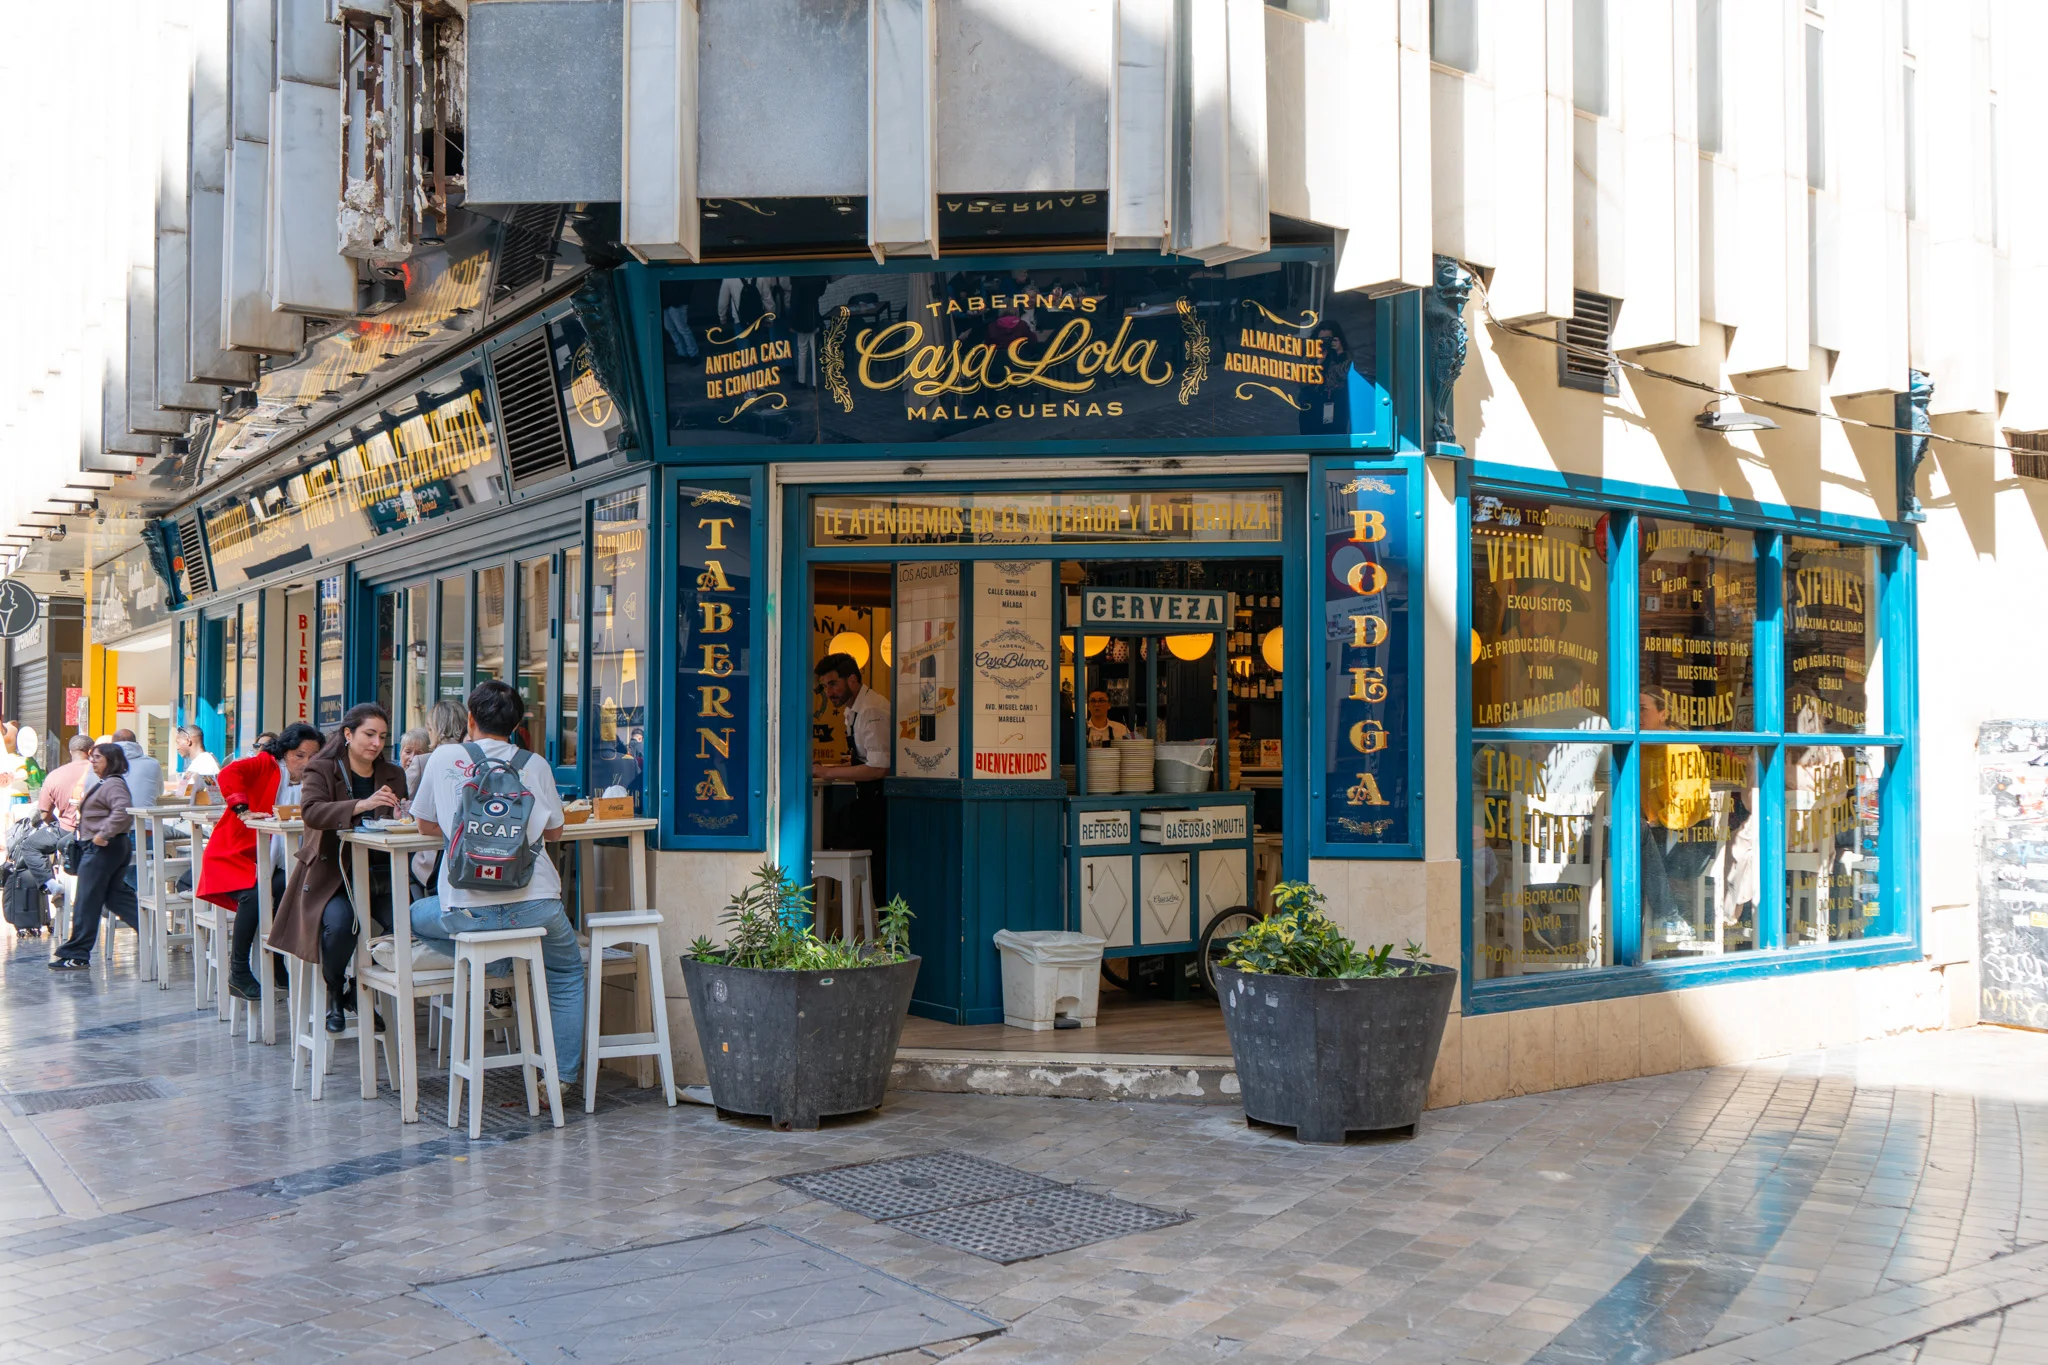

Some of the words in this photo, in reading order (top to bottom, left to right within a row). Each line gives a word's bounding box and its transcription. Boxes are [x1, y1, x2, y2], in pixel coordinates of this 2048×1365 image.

[926, 293, 1097, 317] TABERNAS
[1240, 328, 1302, 357] ALMACÉN
[1306, 339, 1324, 359] DE
[705, 347, 759, 375] ANTIGUA
[760, 340, 792, 362] CASA
[856, 321, 1009, 397] Casa
[1007, 316, 1174, 394] Lola
[1224, 352, 1324, 385] AGUARDIENTES
[707, 381, 723, 399] DE
[725, 366, 781, 397] COMIDAS
[907, 400, 1123, 421] MALAGUEÑAS
[393, 389, 491, 488] GENEROSOS
[824, 509, 844, 535] LE
[849, 507, 964, 535] ATENDEMOS
[971, 507, 994, 534] EN
[1002, 506, 1026, 533] EL
[1029, 505, 1120, 532] INTERIOR
[1130, 504, 1140, 530] Y
[1150, 504, 1173, 531] EN
[1179, 503, 1271, 531] TERRAZA
[1479, 502, 1521, 521] RECETA
[1526, 509, 1596, 530] TRADICIONAL
[598, 529, 642, 559] BARBADILLO
[1646, 528, 1721, 552] ALIMENTACIÓN
[900, 569, 913, 583] LOS
[915, 562, 959, 580] AGUILARES
[1487, 534, 1591, 592] VERMUTS
[1652, 568, 1662, 583] LO
[1662, 576, 1688, 594] MEJOR
[1707, 573, 1716, 589] LO
[988, 588, 1004, 596] CALLE
[1005, 588, 1029, 597] GRANADA
[1692, 590, 1703, 603] DE
[1716, 581, 1741, 599] MEJOR
[1796, 566, 1863, 614] SIFONES
[1002, 600, 1023, 609] MÁLAGA
[1092, 595, 1219, 621] CERVEZA
[1507, 594, 1572, 613] EXQUISITOS
[1796, 615, 1828, 631] MÁXIMA
[1830, 619, 1864, 634] CALIDAD
[1481, 645, 1493, 661] DE
[1496, 636, 1555, 657] PRODUCCIÓN
[1558, 640, 1598, 666] FAMILIAR
[1644, 636, 1684, 653] ABRIMOS
[1685, 639, 1711, 655] TODOS
[1713, 640, 1728, 656] LOS
[1730, 638, 1749, 657] DÍAS
[695, 517, 736, 801] TABERNA
[975, 651, 1006, 670] Casa
[1003, 652, 1049, 670] Blanca
[1347, 510, 1390, 806] BODEGA
[1793, 656, 1808, 672] CON
[1809, 654, 1831, 668] AGUAS
[1528, 665, 1534, 679] Y
[1536, 665, 1554, 680] UNA
[1678, 664, 1718, 681] NUESTRAS
[1818, 674, 1843, 690] BÉBALA
[998, 703, 1017, 711] MIGUEL
[1018, 703, 1033, 712] CANO
[1479, 701, 1518, 725] LARGA
[1523, 684, 1600, 718] MACERACIÓN
[1661, 688, 1734, 726] TABERNAS
[1804, 695, 1833, 719] TODAS
[998, 715, 1026, 724] MARBELLA
[975, 752, 1047, 775] BIENVENIDOS
[1670, 751, 1748, 789] ATENDEMOS
[1484, 749, 1548, 803] TAPAS
[467, 820, 522, 838] RCAF
[1082, 822, 1129, 840] REFRESCO
[1166, 822, 1211, 839] GASEOSAS
[1484, 797, 1579, 855] SELECTAS
[1677, 827, 1689, 843] EN
[1502, 884, 1583, 908] ELABORACIÓN
[1838, 896, 1853, 910] LAS
[1522, 914, 1562, 933] DIARIA
[1477, 943, 1549, 965] PRODUCTOS
